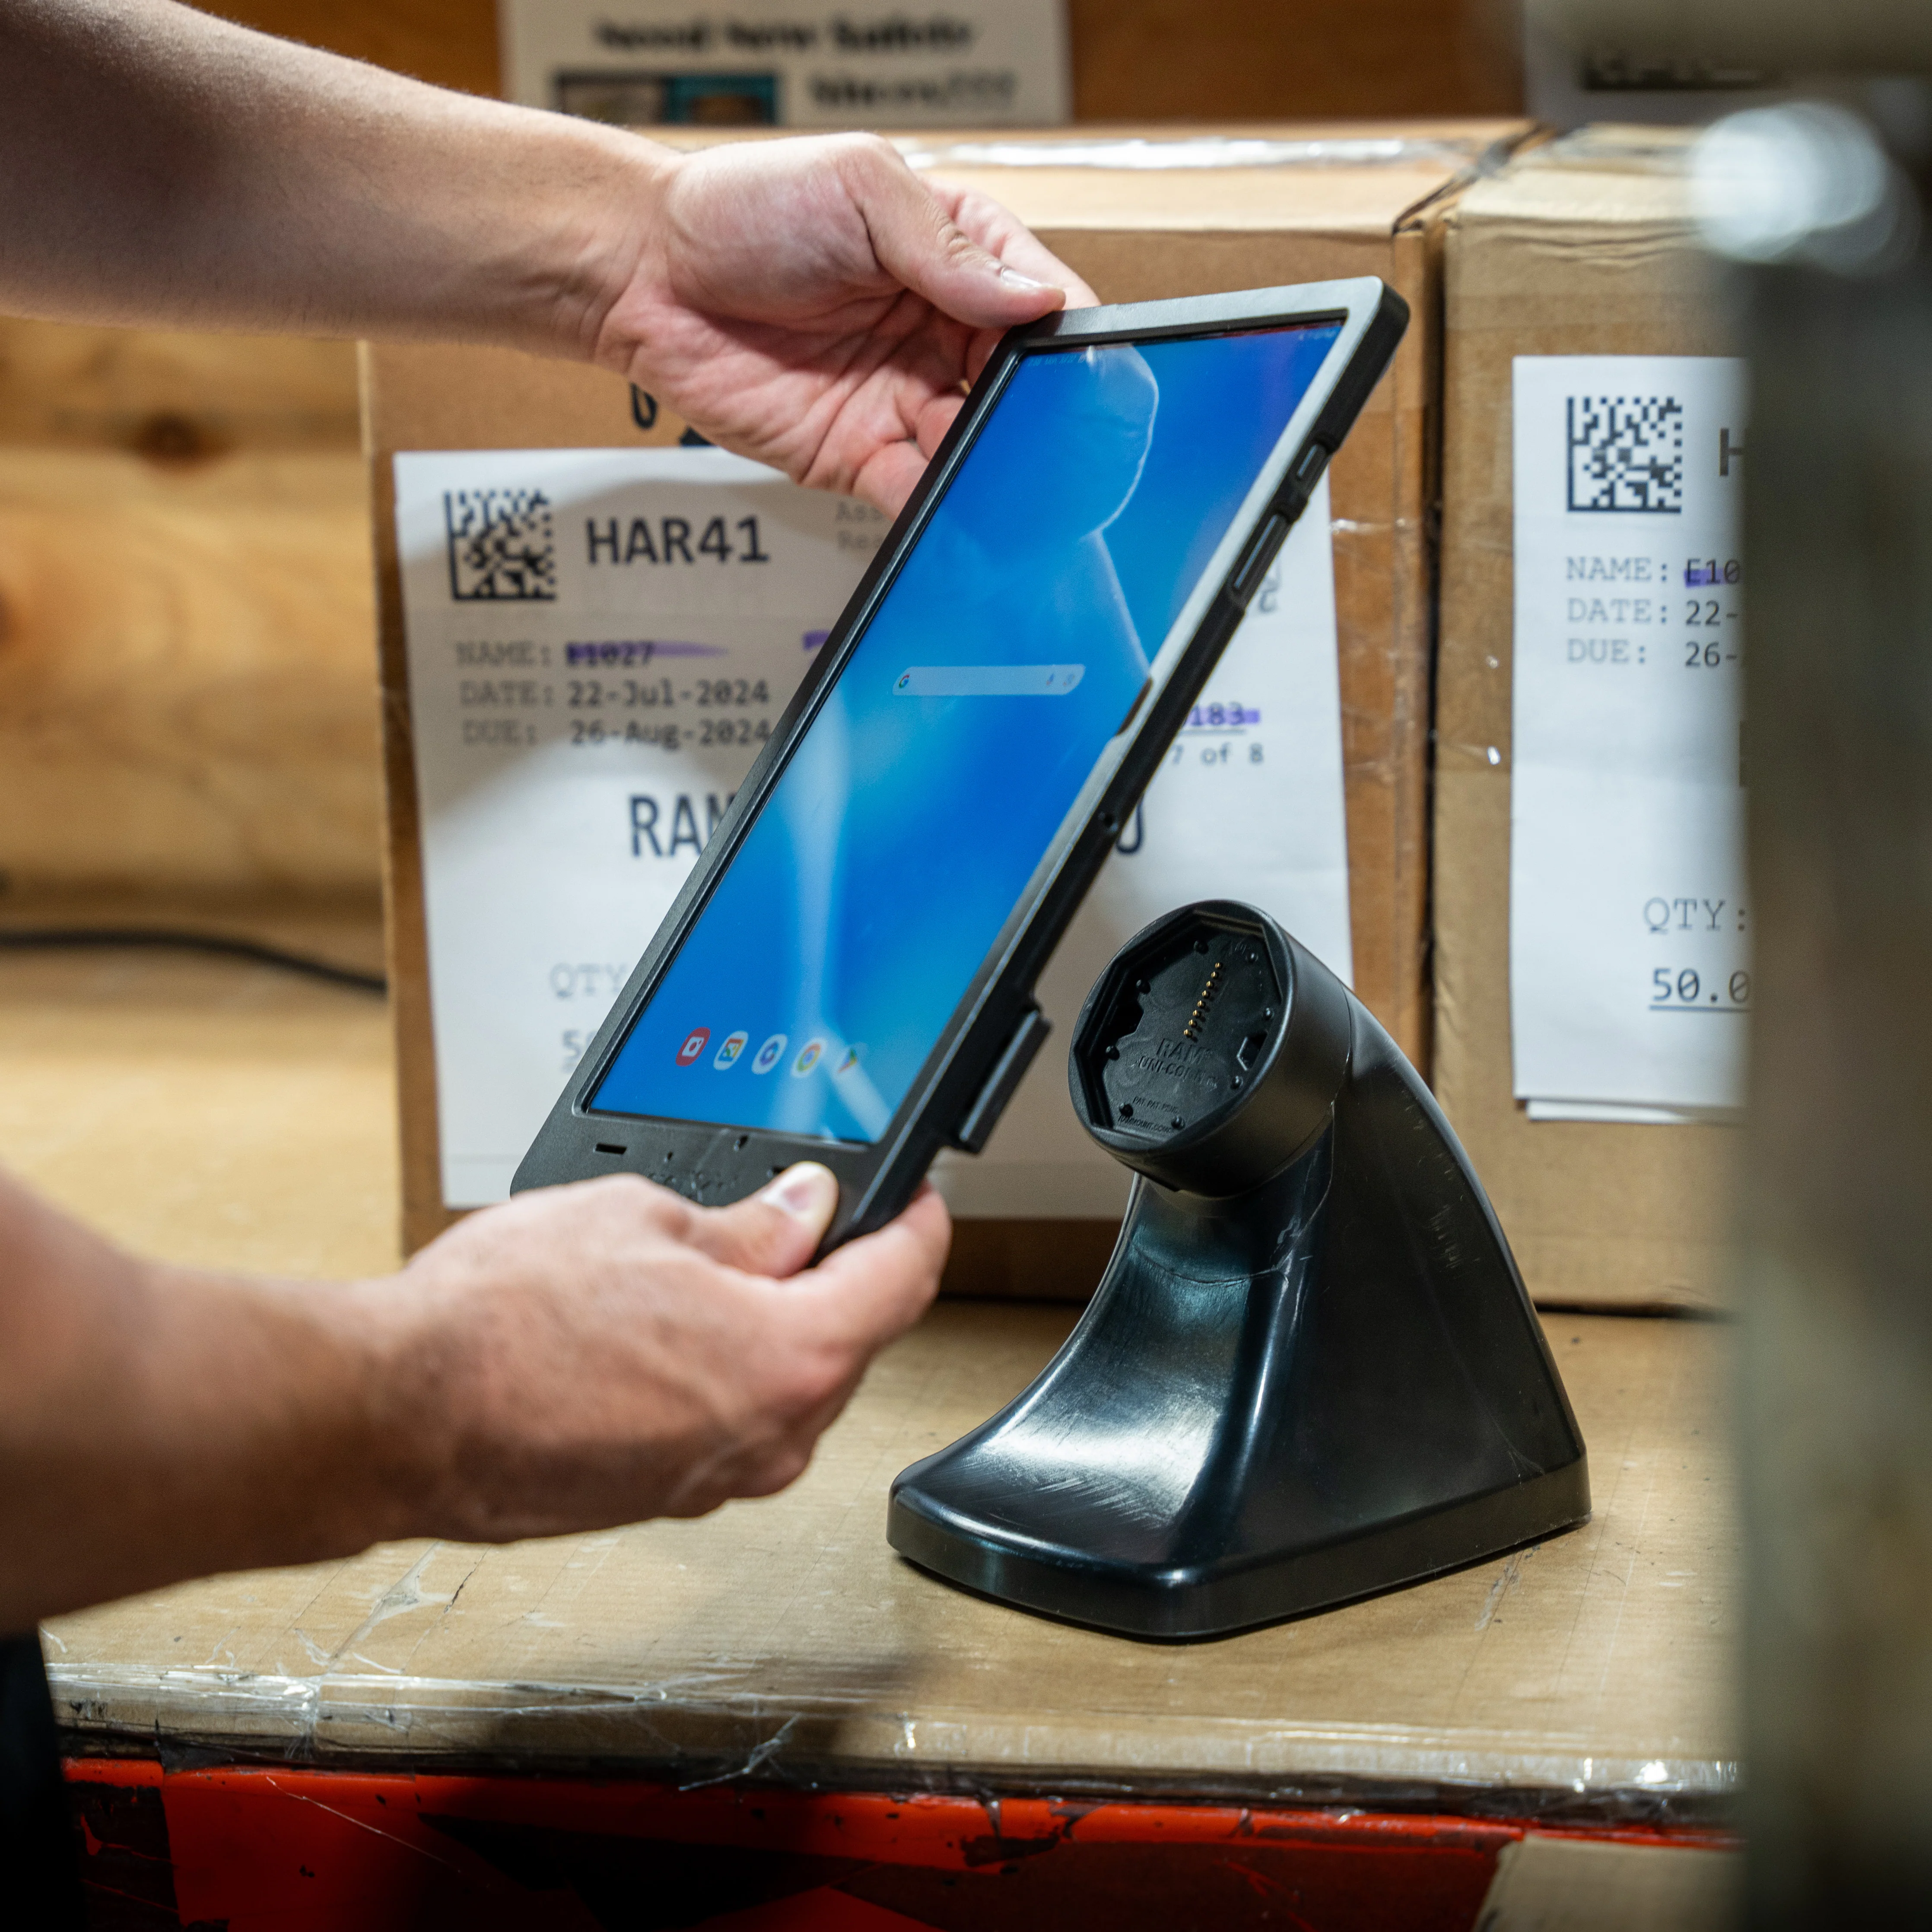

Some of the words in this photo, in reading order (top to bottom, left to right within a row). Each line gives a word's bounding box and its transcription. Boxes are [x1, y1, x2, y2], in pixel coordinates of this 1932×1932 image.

[586, 516, 770, 564] HAR41
[1566, 557, 1667, 580] NAME:
[1567, 598, 1667, 623] DATE:
[1567, 638, 1645, 663] DUE:
[569, 680, 769, 707] 22-Jul-2024
[1183, 702, 1244, 727] 183
[572, 719, 771, 751] 26-Aug-2024
[1644, 897, 1745, 934] QTY:
